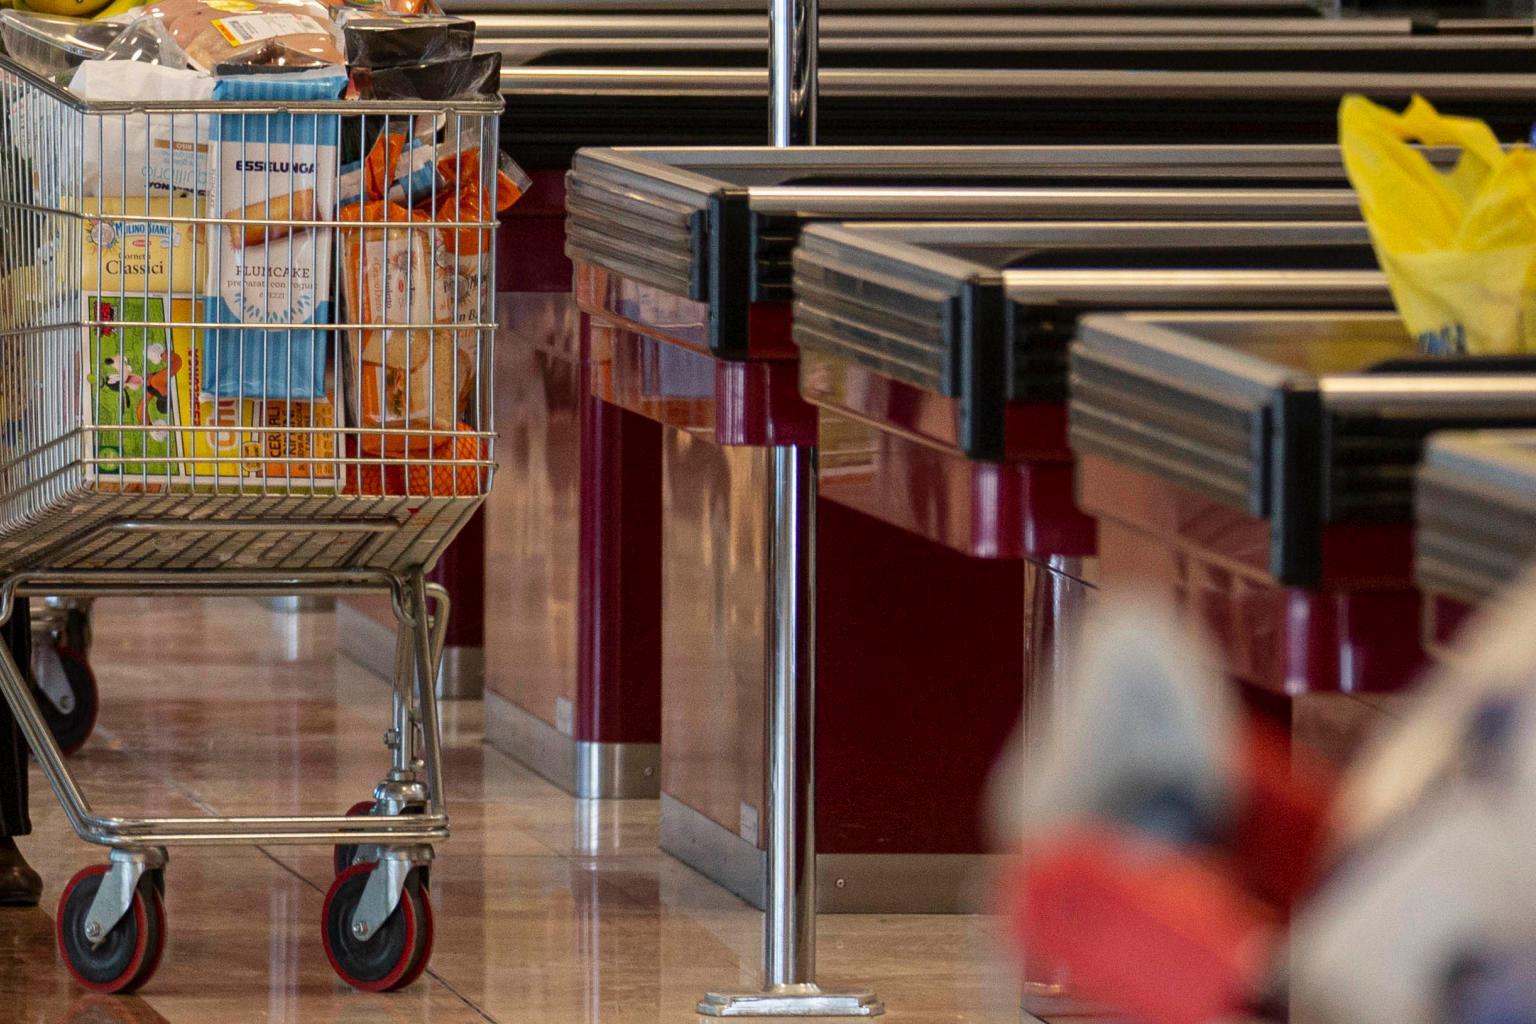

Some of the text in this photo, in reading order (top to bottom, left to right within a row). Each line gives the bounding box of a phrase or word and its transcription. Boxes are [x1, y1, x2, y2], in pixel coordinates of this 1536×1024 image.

[235, 160, 318, 174] ESSELUNGA
[236, 265, 310, 278] PLUMCAKE
[268, 406, 282, 458] CERALI
